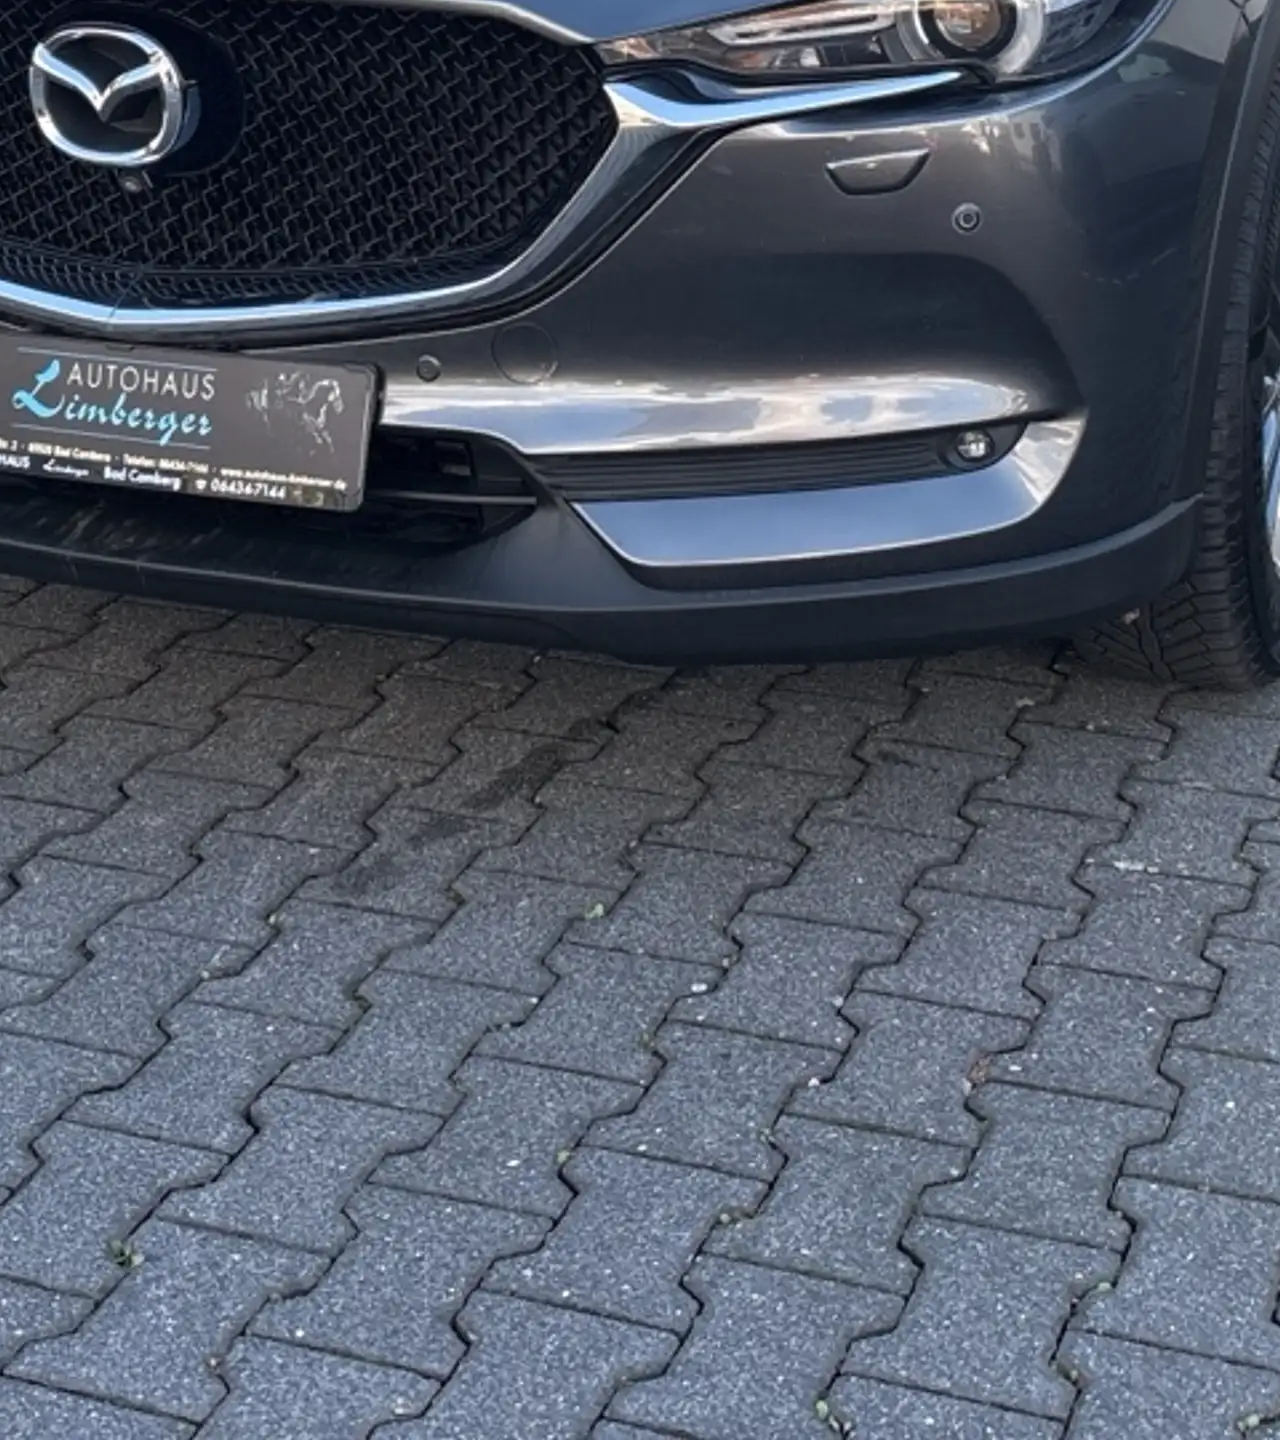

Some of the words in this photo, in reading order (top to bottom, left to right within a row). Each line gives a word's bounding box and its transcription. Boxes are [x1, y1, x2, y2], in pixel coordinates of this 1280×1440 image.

[11, 357, 214, 447] Limberger
[66, 361, 216, 402] AUTOHAUS
[103, 465, 127, 481] Bad
